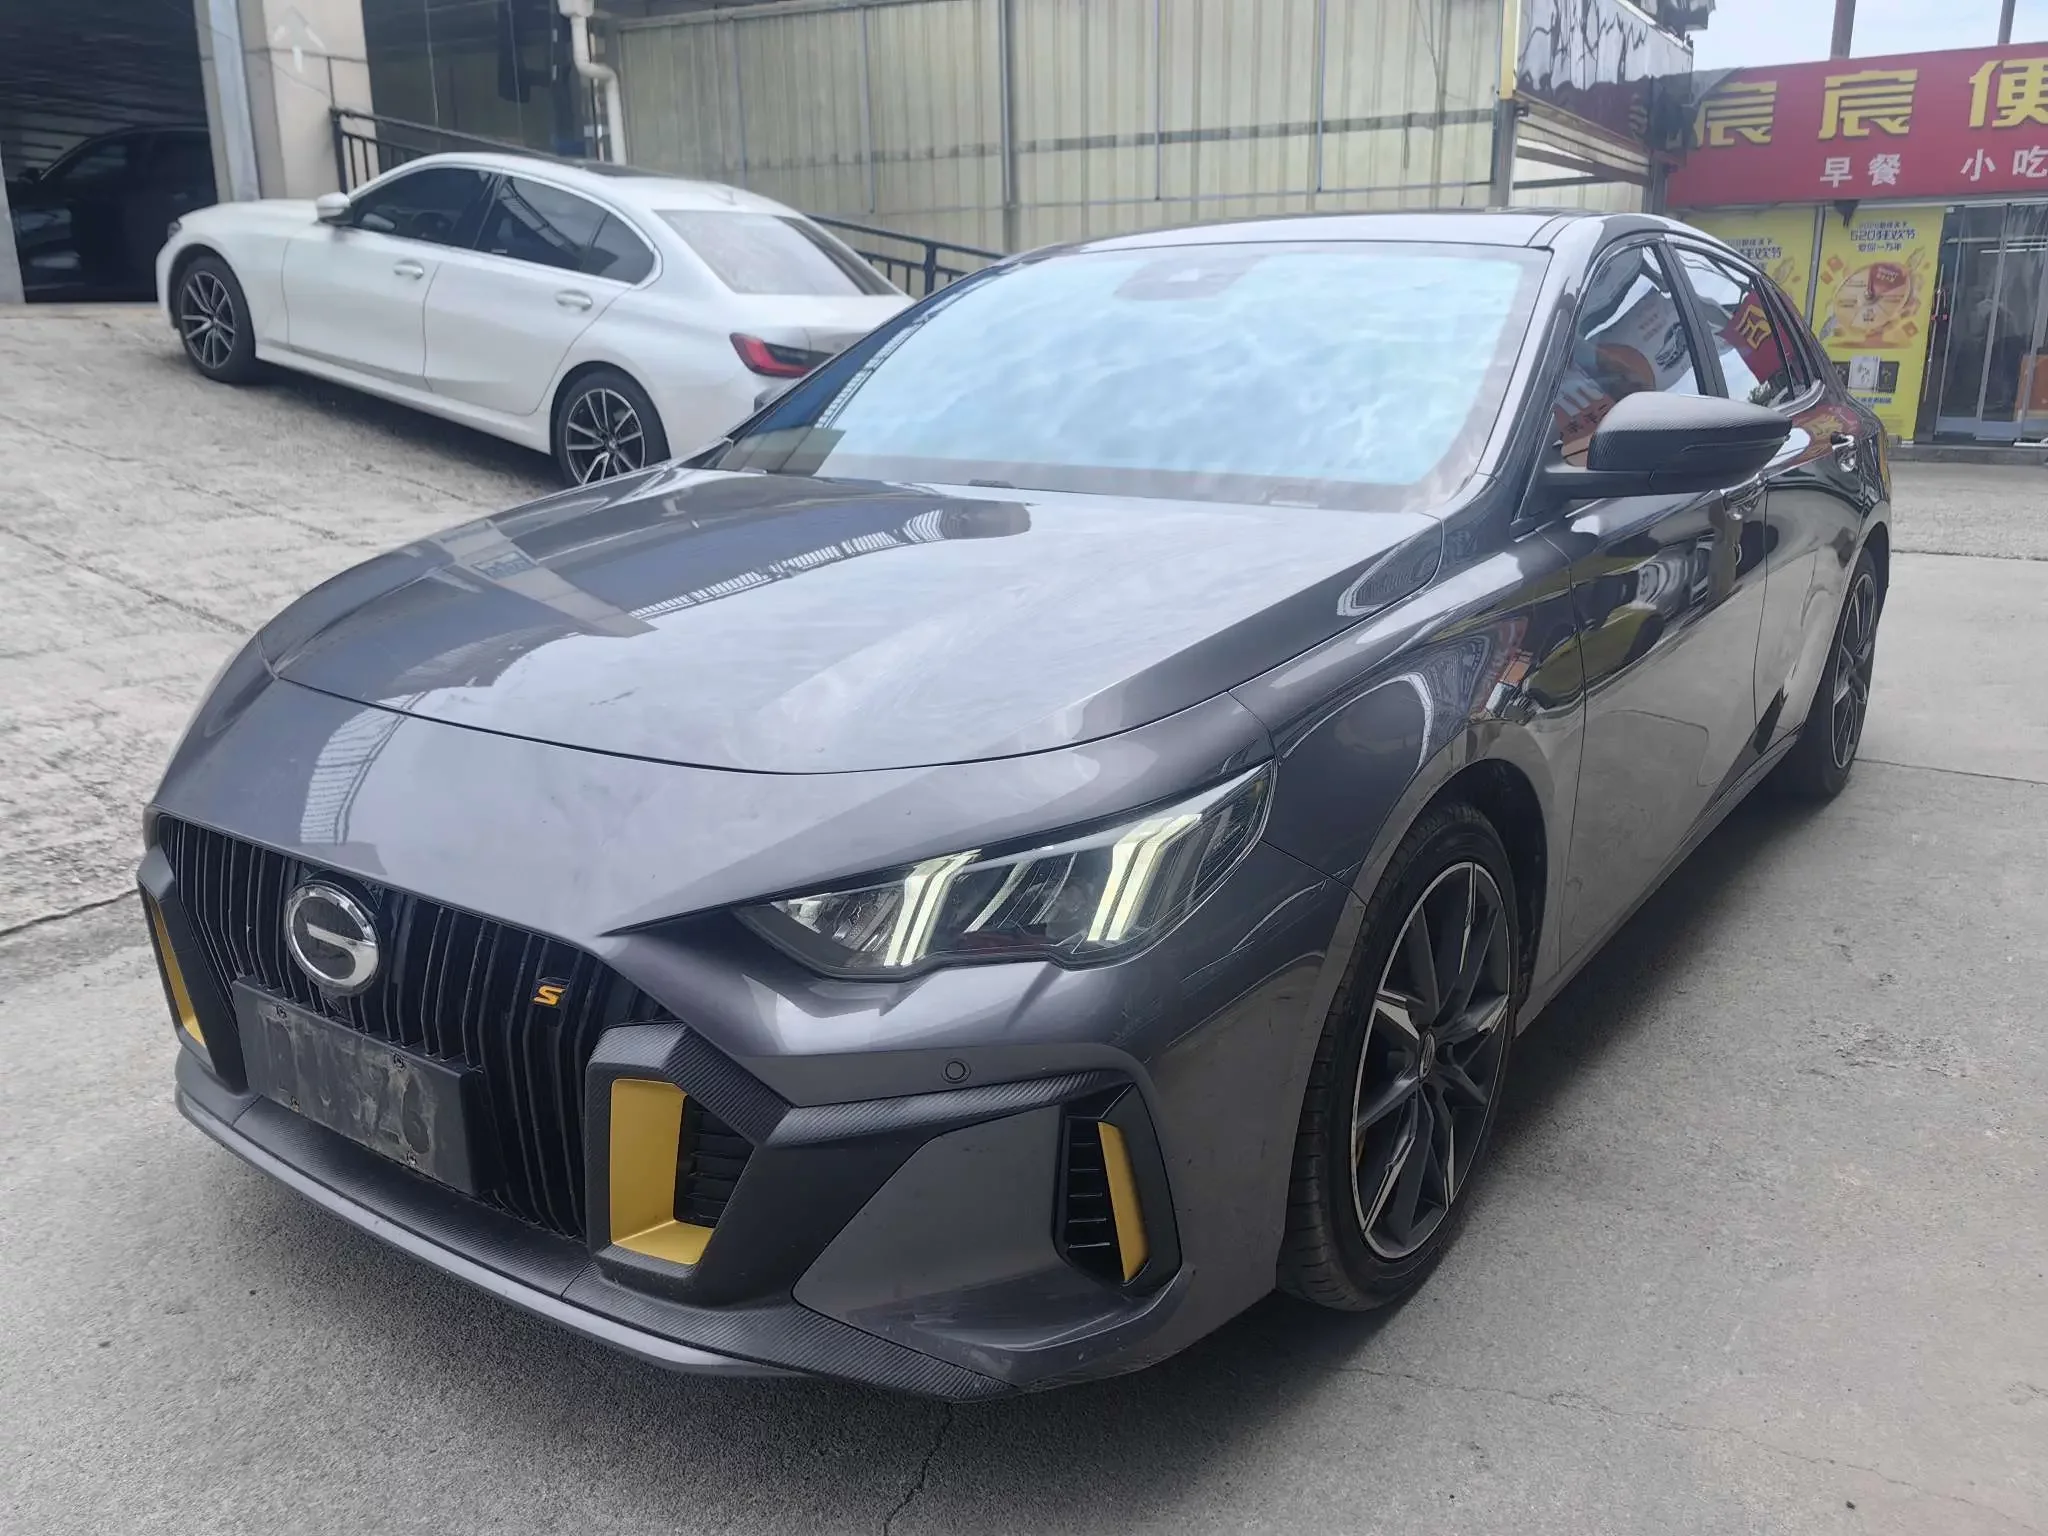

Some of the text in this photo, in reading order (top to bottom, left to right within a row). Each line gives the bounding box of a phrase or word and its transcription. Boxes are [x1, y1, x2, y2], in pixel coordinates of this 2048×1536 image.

[1820, 145, 2048, 188] 早餐 小吃
[533, 985, 566, 1006] S
